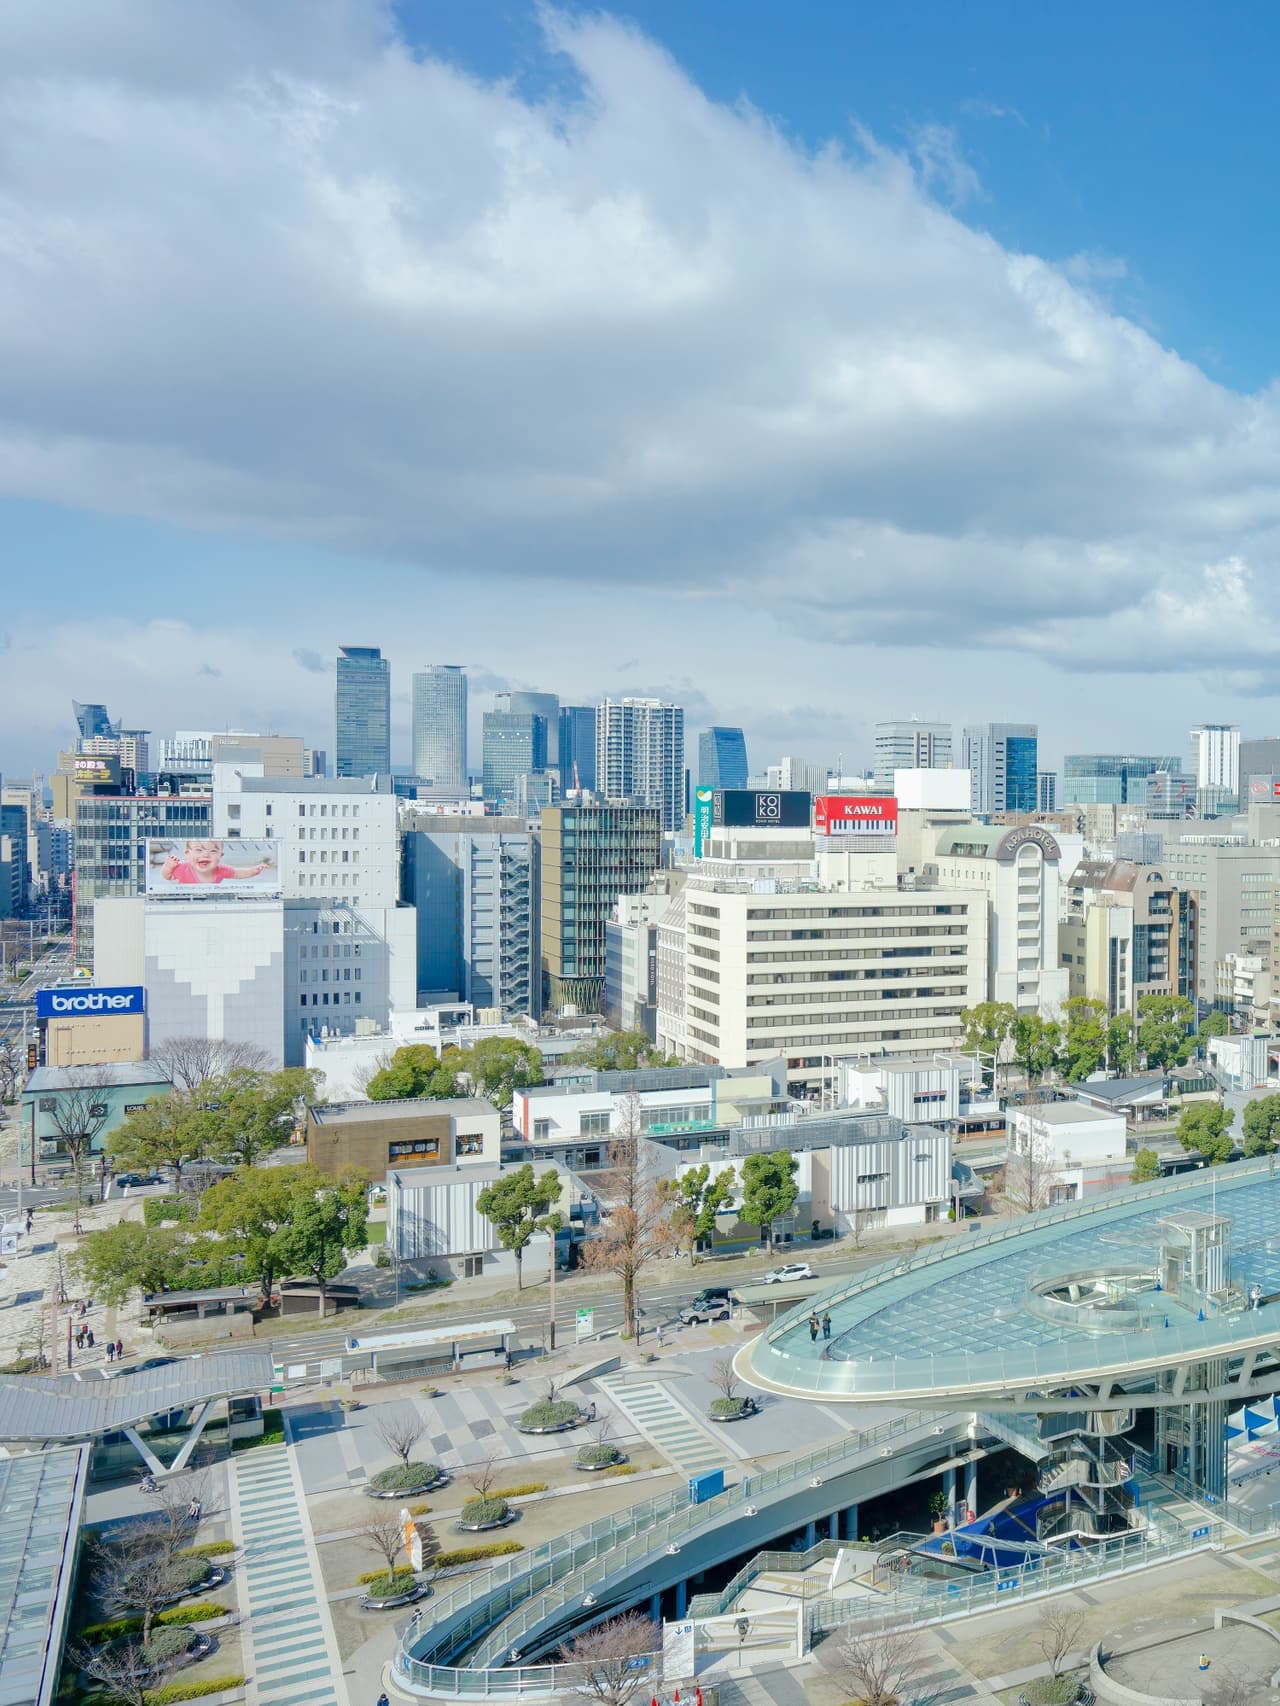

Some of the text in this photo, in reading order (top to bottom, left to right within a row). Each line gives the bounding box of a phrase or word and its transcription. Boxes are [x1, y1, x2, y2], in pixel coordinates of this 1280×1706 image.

[844, 805, 883, 815] KAWAI
[1005, 829, 1056, 852] APA HOTEL
[52, 992, 135, 1011] brother
